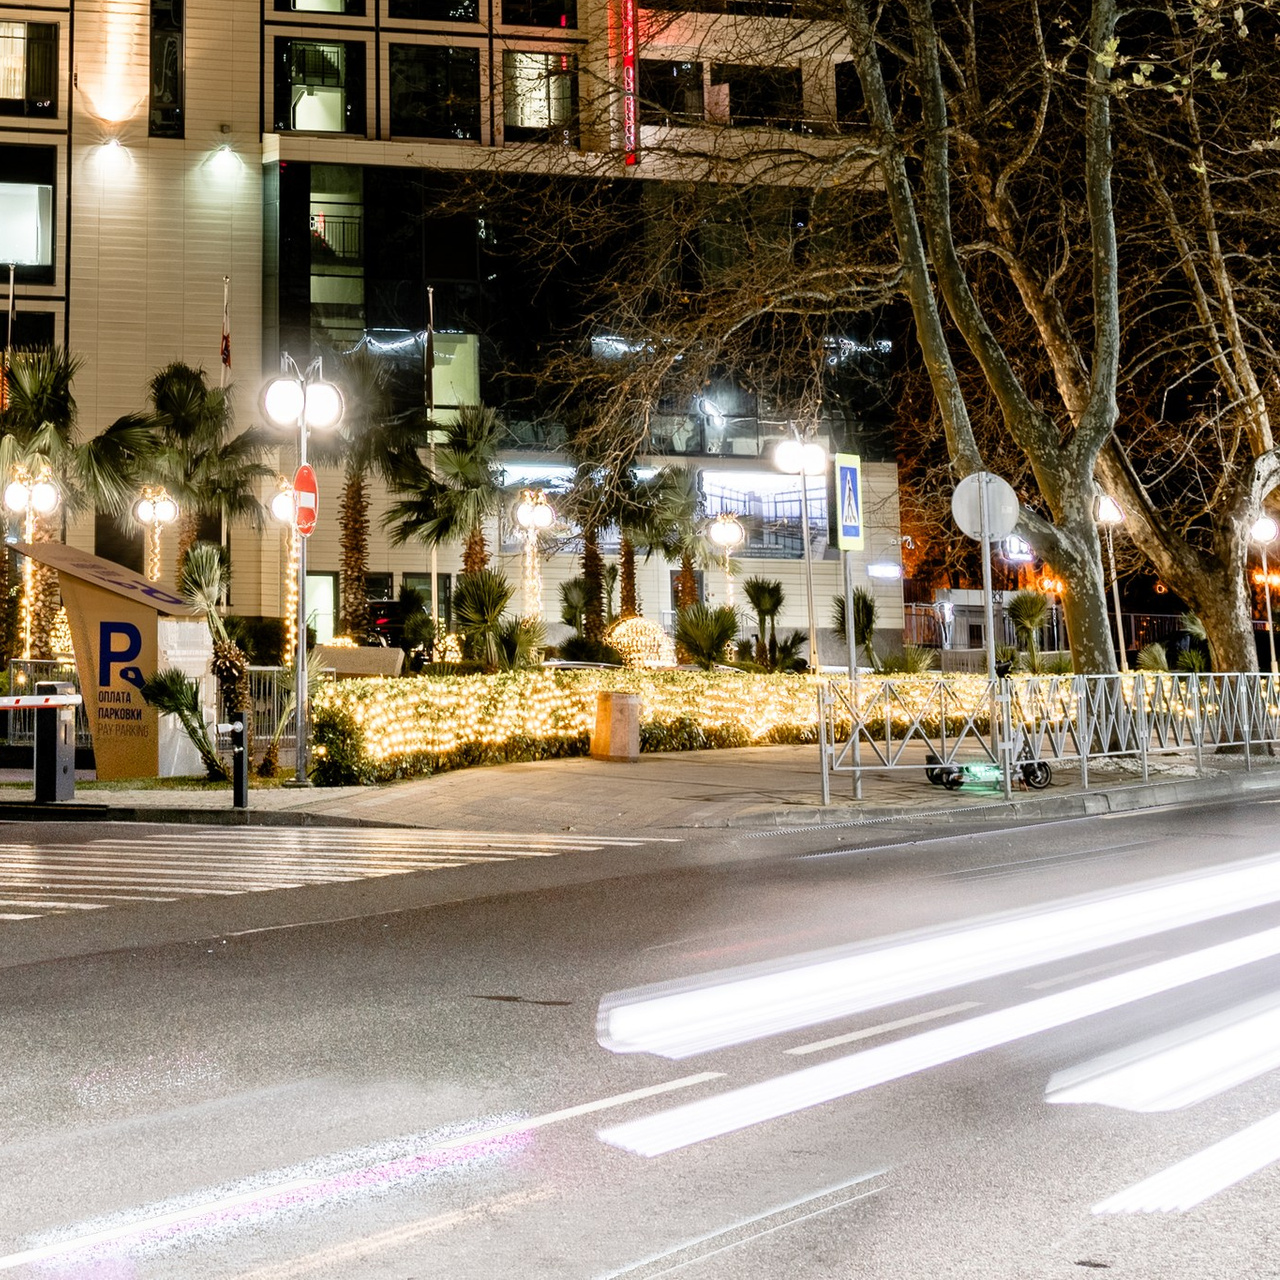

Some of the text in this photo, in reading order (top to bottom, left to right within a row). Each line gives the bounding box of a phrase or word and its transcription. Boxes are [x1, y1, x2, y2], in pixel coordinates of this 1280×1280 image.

[98, 690, 131, 704] ОПЛАТА
[98, 707, 142, 721] ПАРКОВКИ
[97, 722, 149, 738] PAY PARKING
